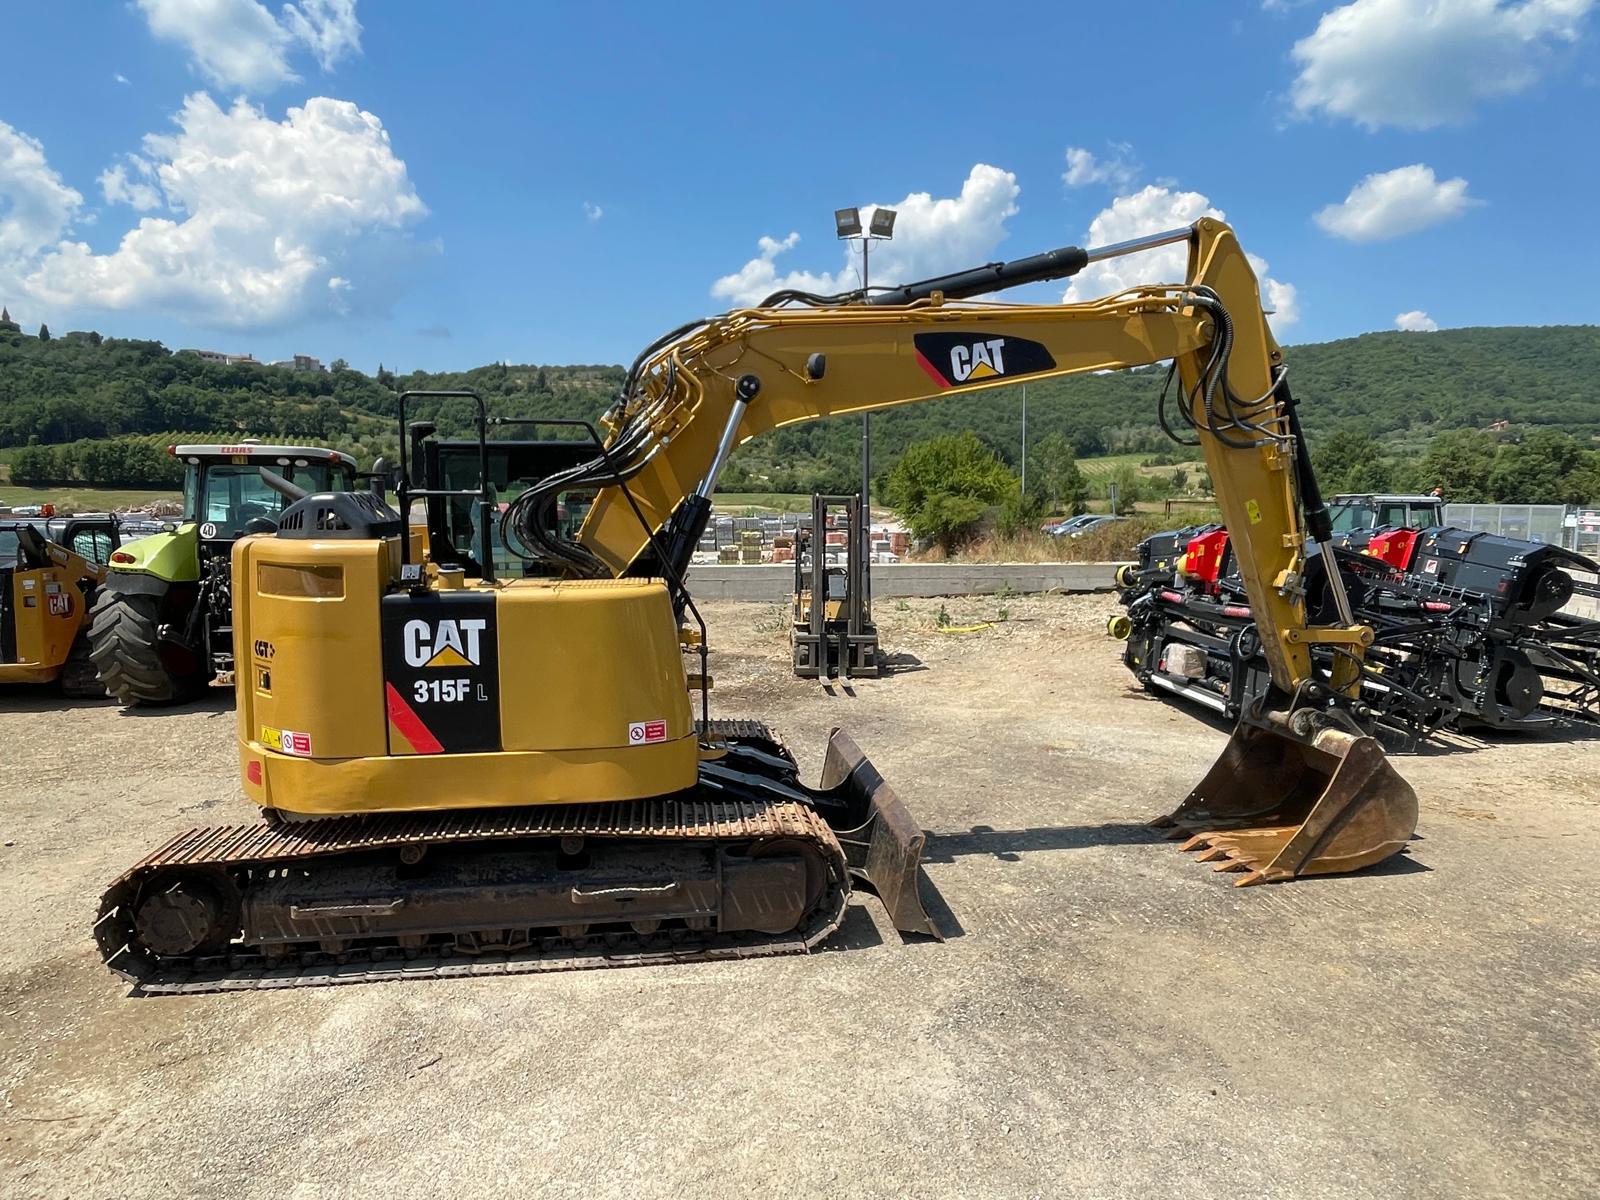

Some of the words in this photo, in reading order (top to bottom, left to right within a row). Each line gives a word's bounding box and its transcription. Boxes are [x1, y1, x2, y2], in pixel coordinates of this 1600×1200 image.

[950, 338, 1005, 382] CAT
[203, 525, 213, 536] 40
[49, 593, 70, 615] CAT
[403, 619, 486, 668] CAT
[413, 679, 471, 703] 315F
[477, 683, 488, 701] L
